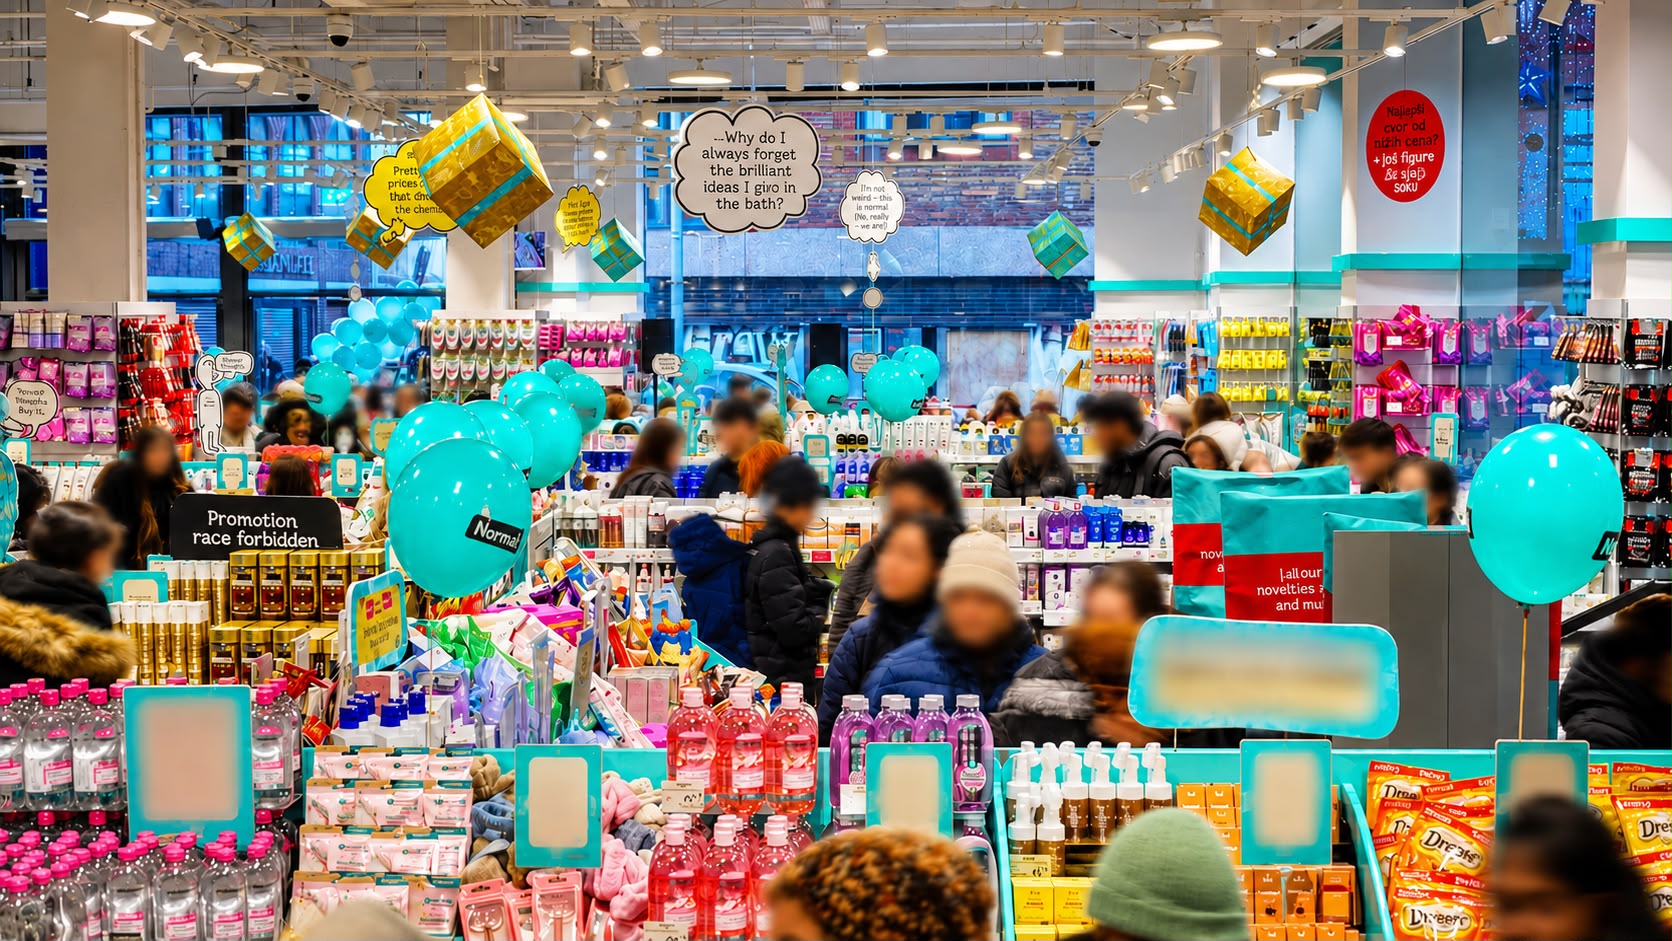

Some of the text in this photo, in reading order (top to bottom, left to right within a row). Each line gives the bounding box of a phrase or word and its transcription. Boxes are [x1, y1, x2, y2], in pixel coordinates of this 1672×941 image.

[1412, 119, 1426, 131] od
[759, 131, 776, 144] do
[780, 131, 786, 144] I
[1405, 134, 1439, 147] cena?
[702, 146, 796, 164] always forget
[1400, 151, 1434, 166] figure
[393, 166, 420, 178] Prett
[710, 164, 792, 177] the brilliant
[388, 180, 417, 191] prices
[704, 181, 740, 194] ideas
[744, 181, 750, 194] I
[784, 181, 797, 194] in
[874, 184, 885, 192] not
[716, 197, 784, 210] the bath?
[879, 193, 893, 202] this
[395, 204, 411, 213] the
[207, 510, 298, 529] Promotion
[192, 530, 320, 549] race forbidden
[473, 519, 521, 549] Normal
[1201, 550, 1224, 560] nov
[1301, 569, 1323, 579] our
[1257, 583, 1315, 596] novelties
[1276, 598, 1299, 611] and
